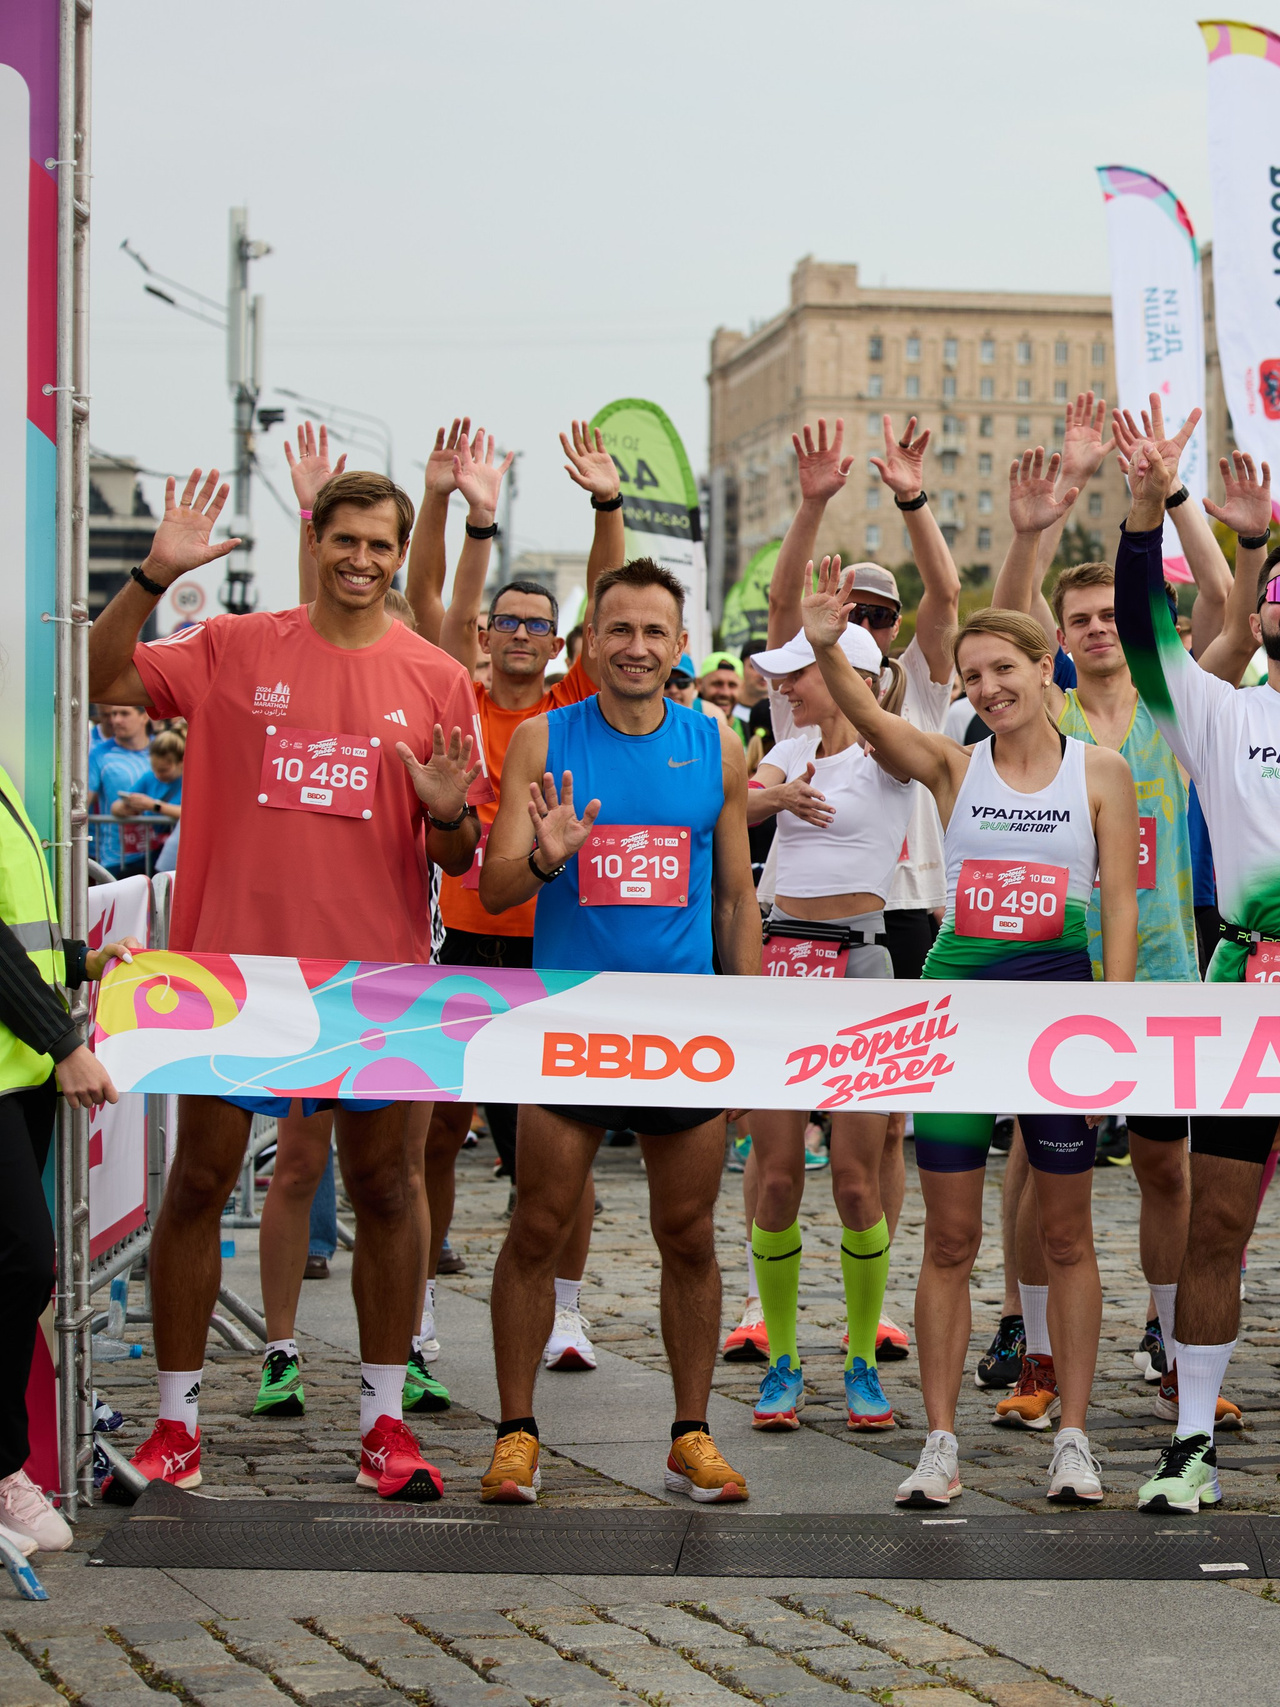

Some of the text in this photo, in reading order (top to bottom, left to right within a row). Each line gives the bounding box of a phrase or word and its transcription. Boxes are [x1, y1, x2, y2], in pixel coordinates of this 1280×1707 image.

[254, 693, 290, 704] DUBAI
[254, 701, 288, 709] MARATHON
[341, 746, 352, 756] 10
[271, 757, 369, 791] 10 486
[306, 792, 327, 801] BBDO
[971, 805, 1071, 823] УРАЛХИМ
[979, 820, 1058, 834] RUNFACTORY
[652, 837, 664, 846] 10
[590, 854, 679, 880] 10 219
[1029, 874, 1040, 883] 10
[964, 887, 1057, 917] 10 490
[998, 920, 1018, 929] BBDO
[814, 948, 825, 957] 10
[784, 994, 960, 1086] Добрый
[541, 1031, 736, 1082] BBDO
[815, 1050, 957, 1109] забег
[1038, 1139, 1084, 1148] УРАЛХИМ
